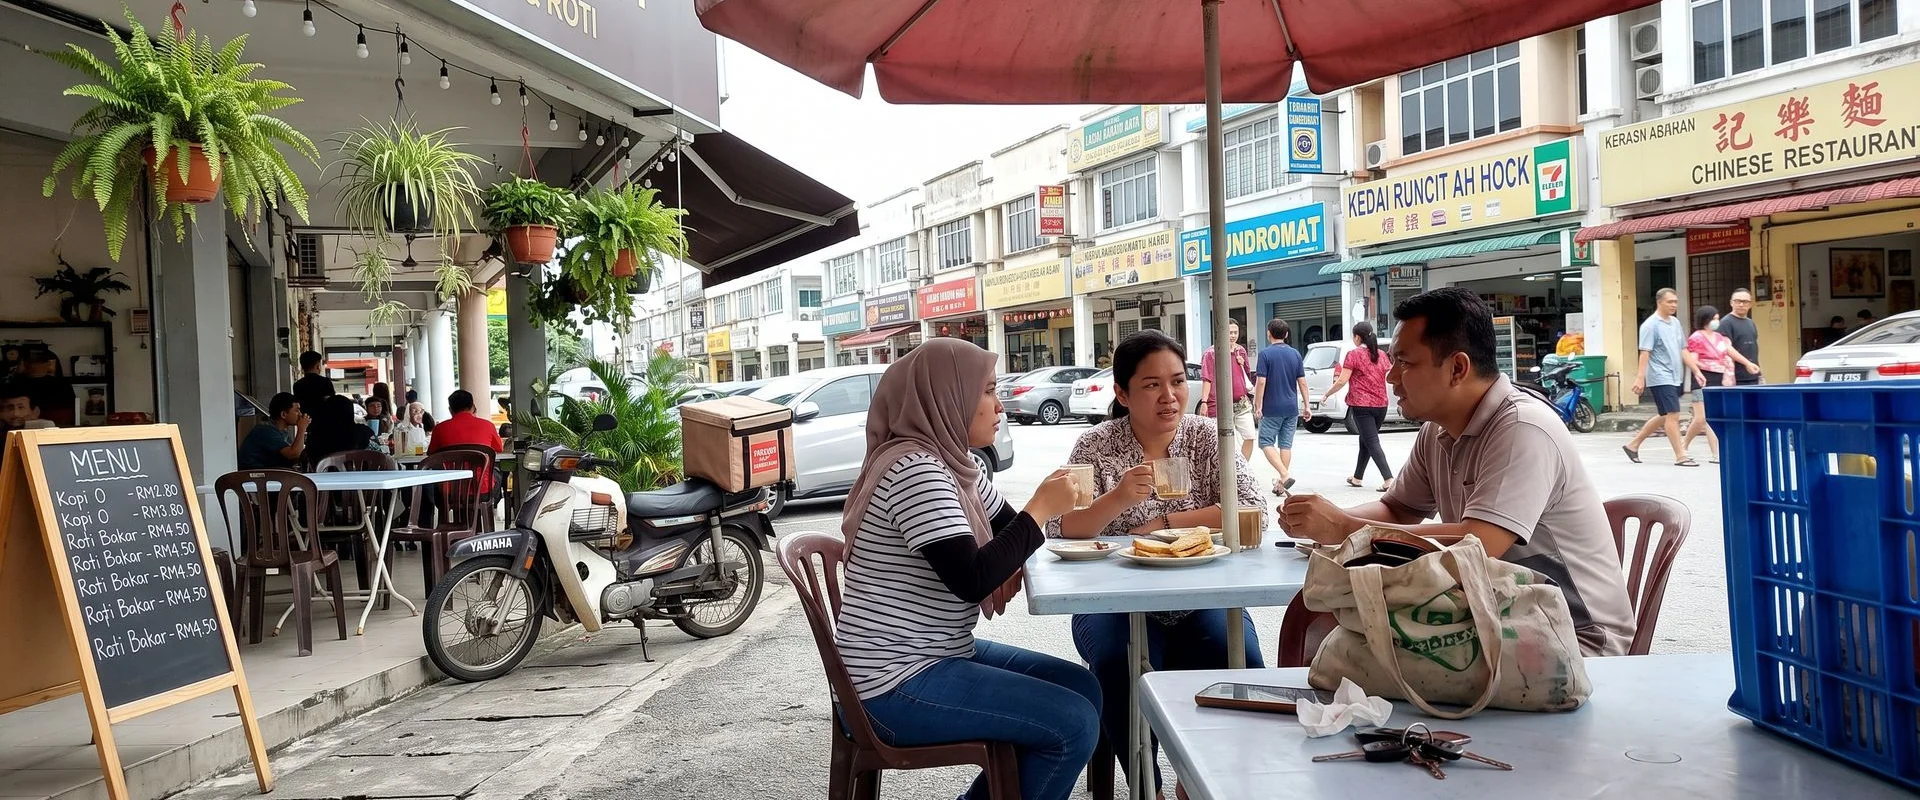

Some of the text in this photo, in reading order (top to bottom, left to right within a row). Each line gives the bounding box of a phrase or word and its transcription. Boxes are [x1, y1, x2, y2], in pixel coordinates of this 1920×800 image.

[1605, 128, 1647, 149] KERASN
[1692, 125, 1920, 185] CHINESE RESTAURAN
[1348, 154, 1530, 218] KEDAI RUNCIT AH HOCK
[69, 446, 142, 476] MENU
[55, 490, 89, 511] Kopi
[61, 511, 93, 531] Kopi
[66, 532, 96, 550] Roti
[98, 528, 138, 547] Bakar
[470, 537, 513, 552] YAMAHA
[72, 553, 101, 573] Roti
[103, 549, 143, 568] Bakar
[77, 577, 108, 598] Roti
[110, 571, 150, 592] Bakar
[117, 597, 156, 618] Bakar
[94, 634, 126, 661] Roti
[127, 628, 167, 654] Bakar
